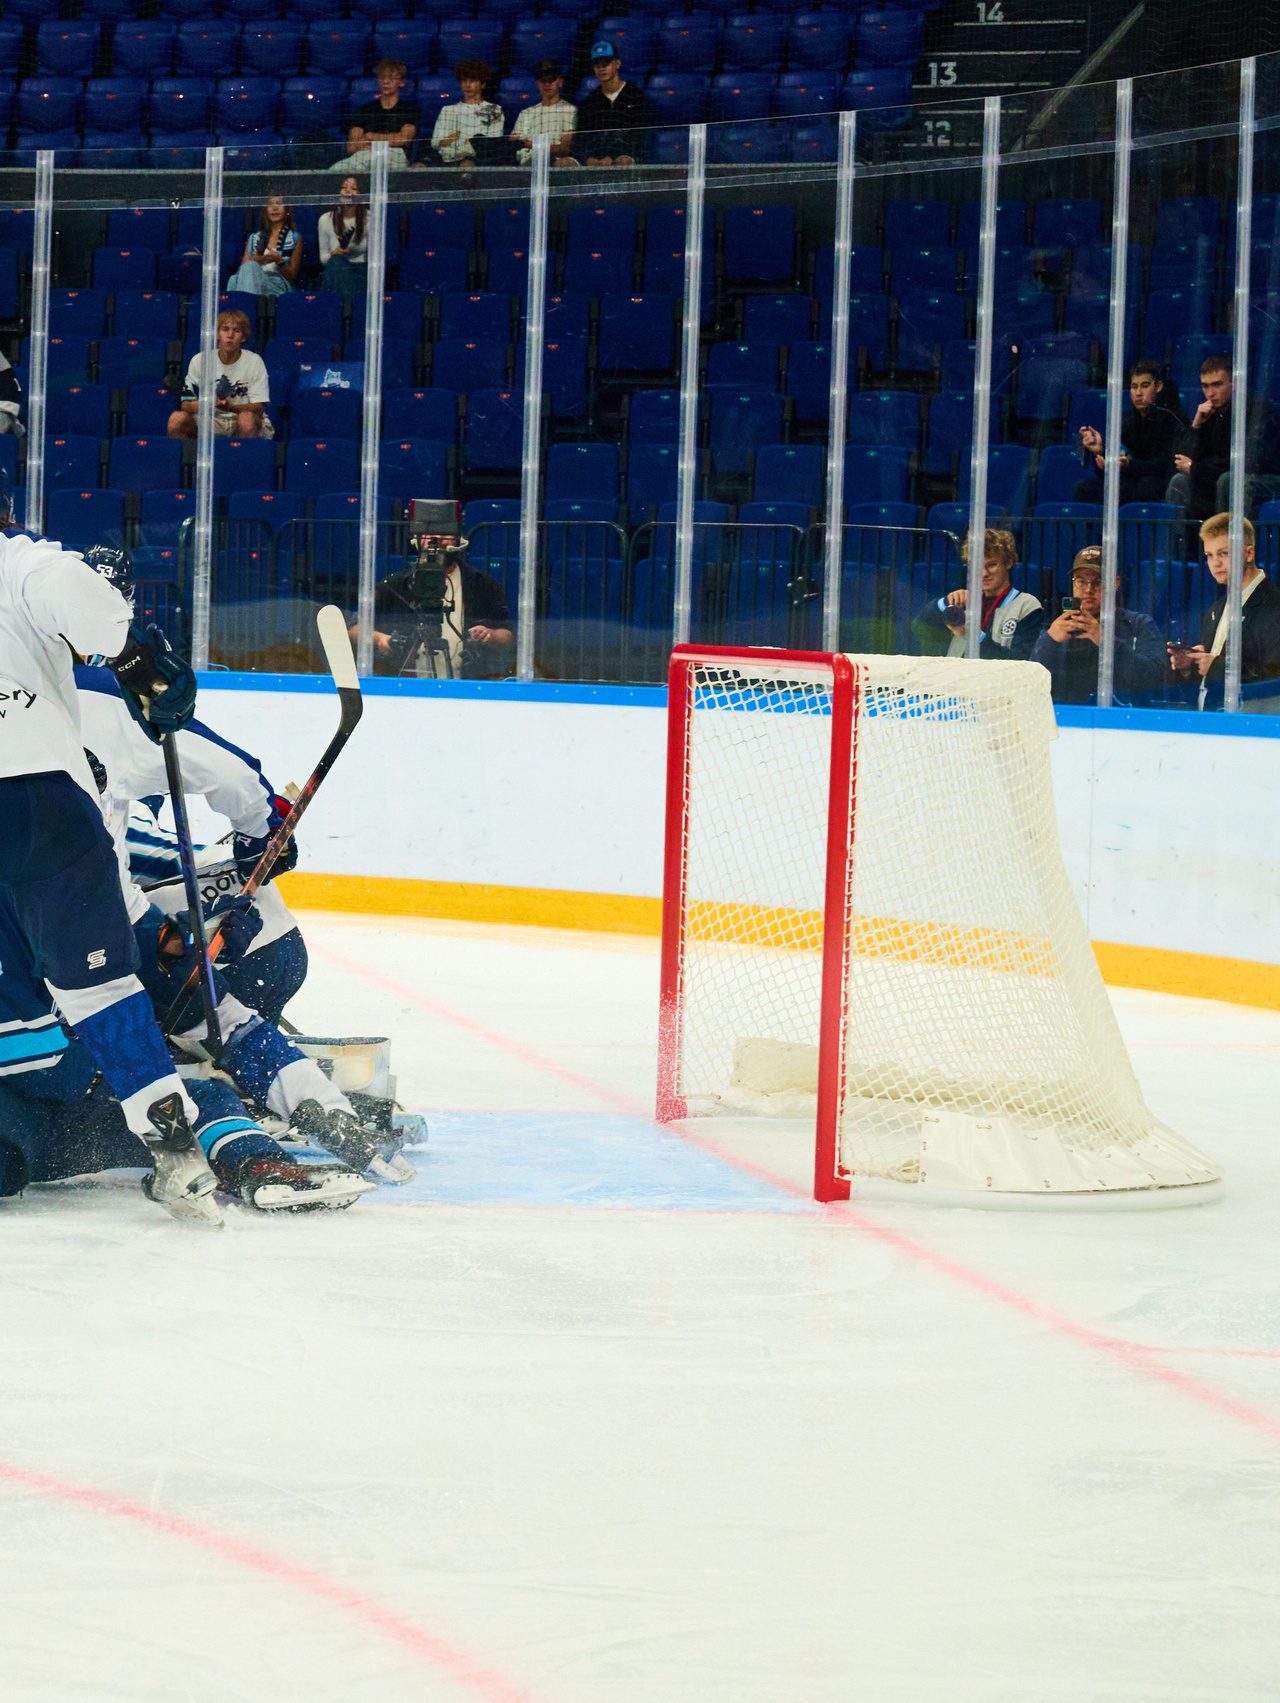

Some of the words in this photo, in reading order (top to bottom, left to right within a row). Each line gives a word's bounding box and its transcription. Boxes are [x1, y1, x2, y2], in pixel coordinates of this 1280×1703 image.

[976, 2, 1004, 23] 14
[928, 62, 957, 86] 13
[923, 121, 951, 144] 12
[97, 564, 113, 578] 53
[118, 655, 141, 672] CCM
